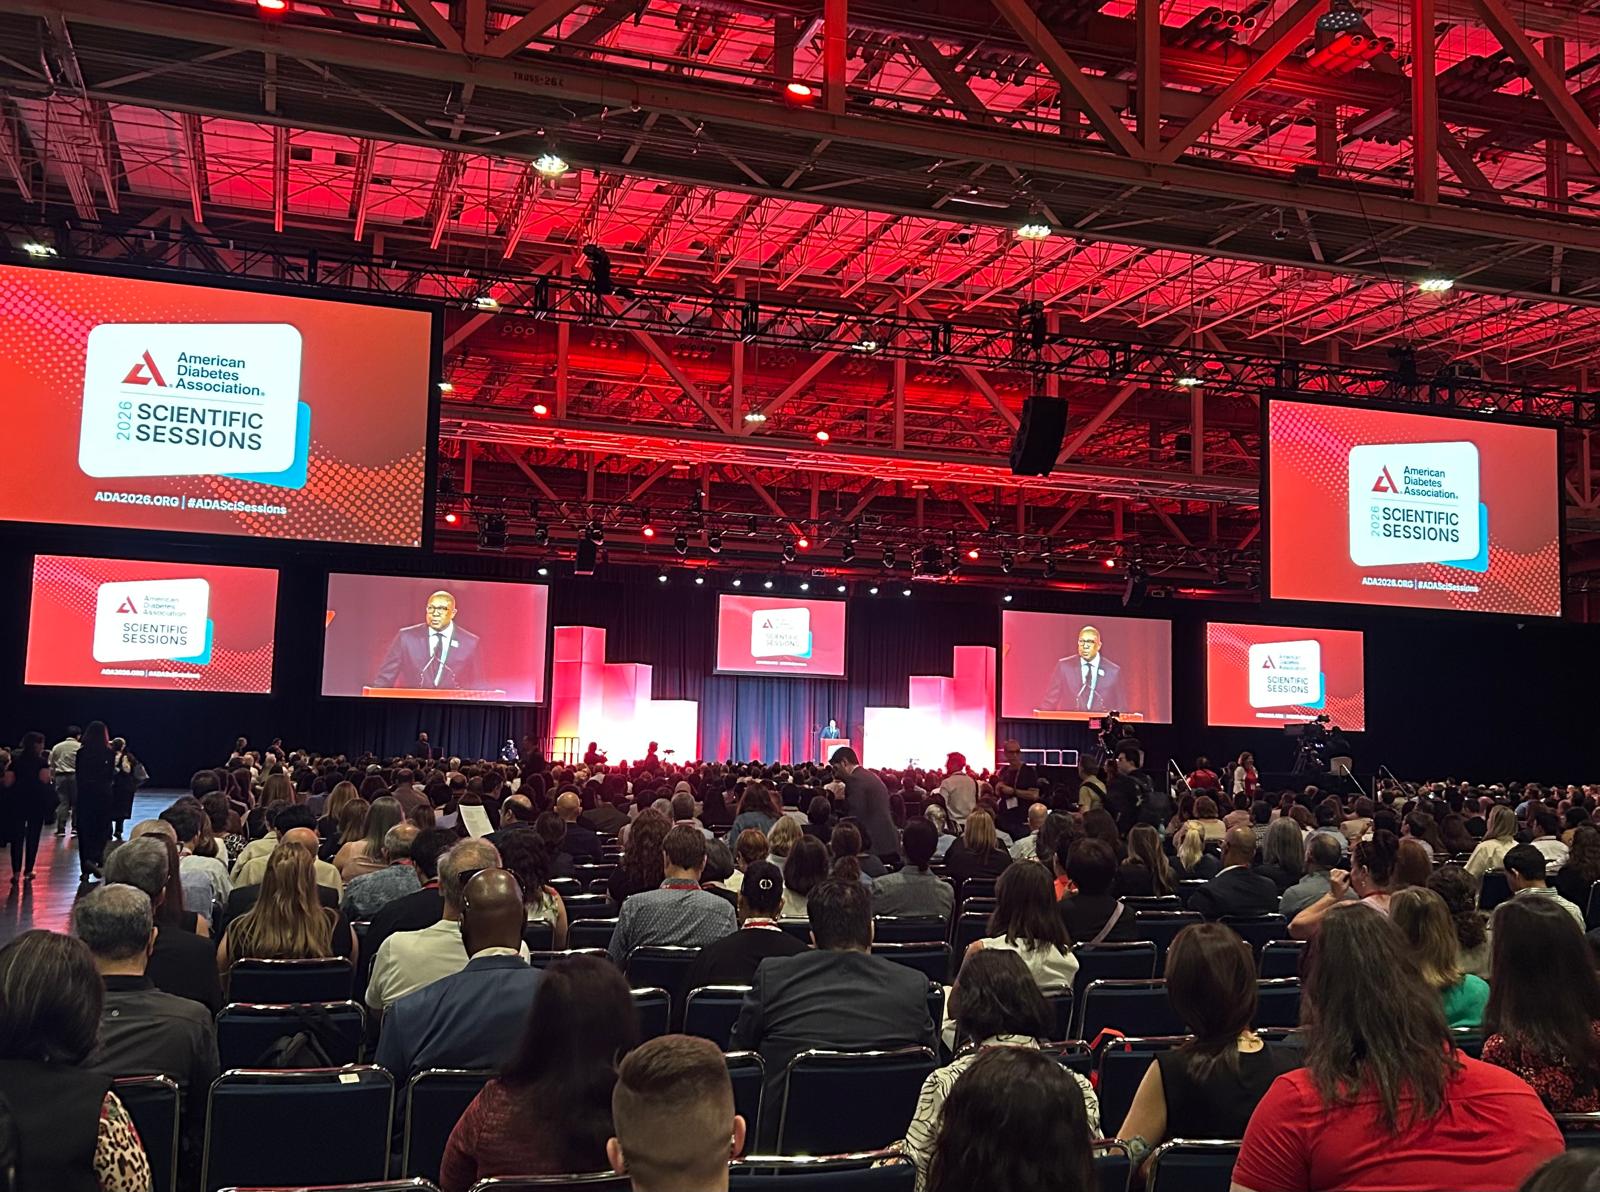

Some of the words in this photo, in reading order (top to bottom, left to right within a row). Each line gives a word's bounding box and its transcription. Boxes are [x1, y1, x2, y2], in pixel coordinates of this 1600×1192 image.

[177, 352, 246, 369] American
[177, 365, 239, 381] Diabetes
[116, 400, 132, 441] 2026
[136, 402, 264, 430] SCIENTIFIC
[135, 423, 263, 451] SESSIONS
[1403, 465, 1446, 478] American
[1403, 475, 1443, 488] Diabetes
[94, 491, 180, 508] ADA2026.ORG
[188, 497, 288, 515] #ADASciSessions
[1381, 507, 1459, 526] SCIENTIFIC
[1381, 523, 1460, 543] SESSIONS
[123, 622, 188, 635] SCIENTIFIC
[122, 633, 188, 646] SESSIONS
[1267, 675, 1309, 685] SCIENTIFIC
[1267, 685, 1309, 694] SESSIONS
